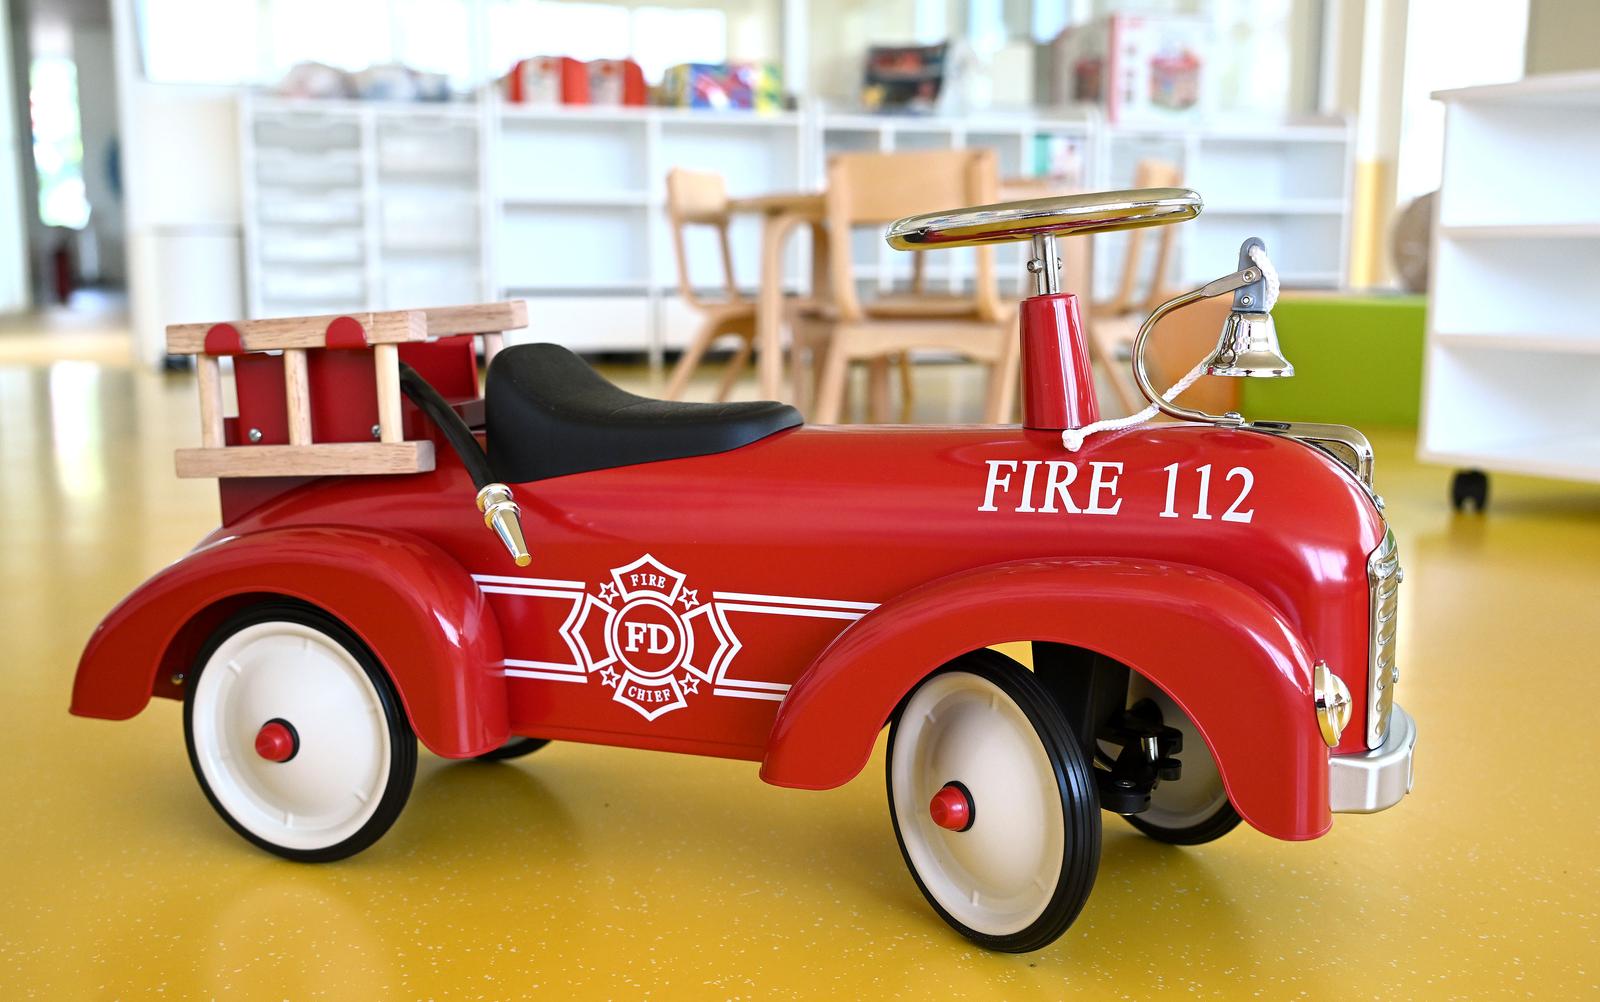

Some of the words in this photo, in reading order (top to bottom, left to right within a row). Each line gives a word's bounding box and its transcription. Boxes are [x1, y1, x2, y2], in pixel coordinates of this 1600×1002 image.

[977, 460, 1124, 516] FIRE
[1159, 463, 1255, 523] 112
[631, 573, 666, 588] FIRE
[625, 621, 675, 655] FD
[628, 686, 671, 702] CHIEF
